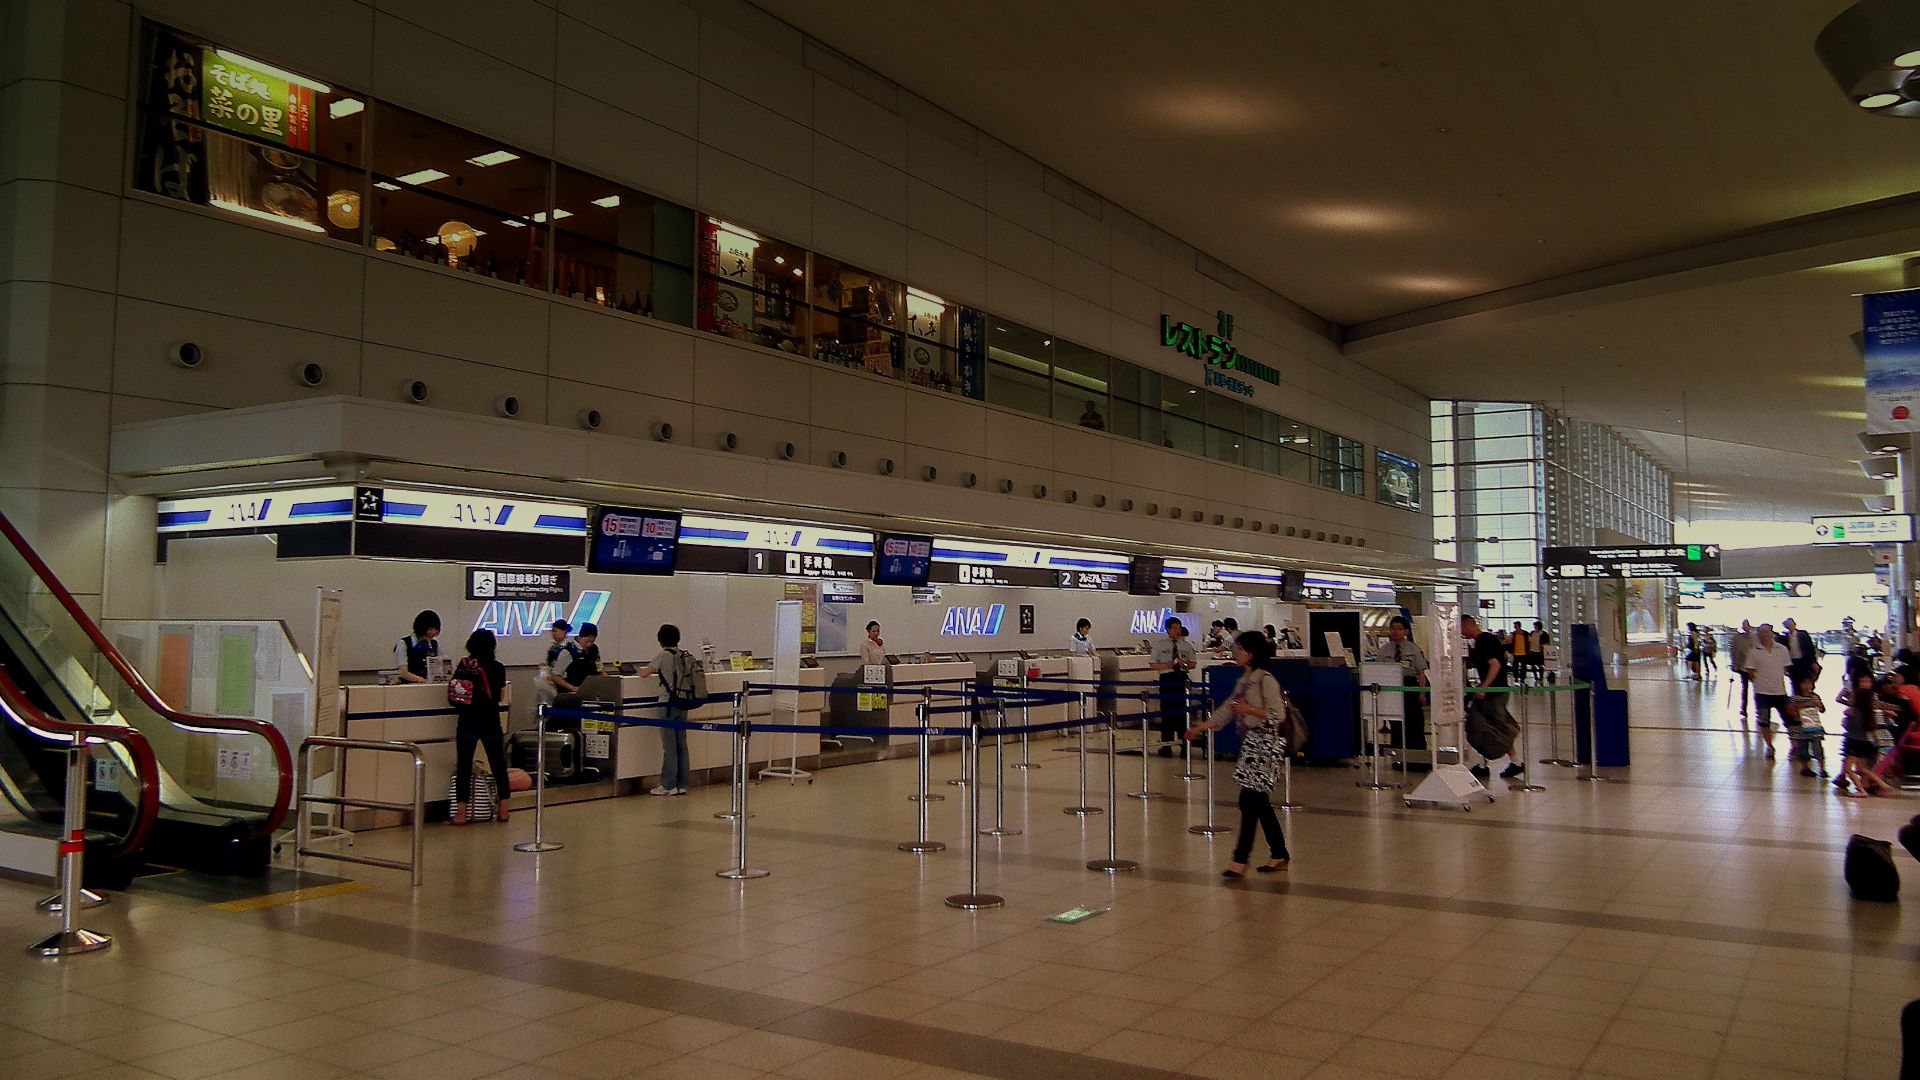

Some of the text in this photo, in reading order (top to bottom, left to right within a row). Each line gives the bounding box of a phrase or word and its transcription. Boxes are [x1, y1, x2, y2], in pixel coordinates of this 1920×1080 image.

[209, 63, 271, 101] そば処
[208, 86, 284, 136] 菜の里
[1160, 314, 1237, 369] レストラン
[605, 518, 618, 532] 15
[754, 552, 763, 570] 1
[1061, 572, 1072, 586] 2
[1159, 578, 1170, 591] 3
[472, 599, 565, 637] ANA
[941, 606, 984, 636] ANA
[1130, 609, 1159, 634] ANA
